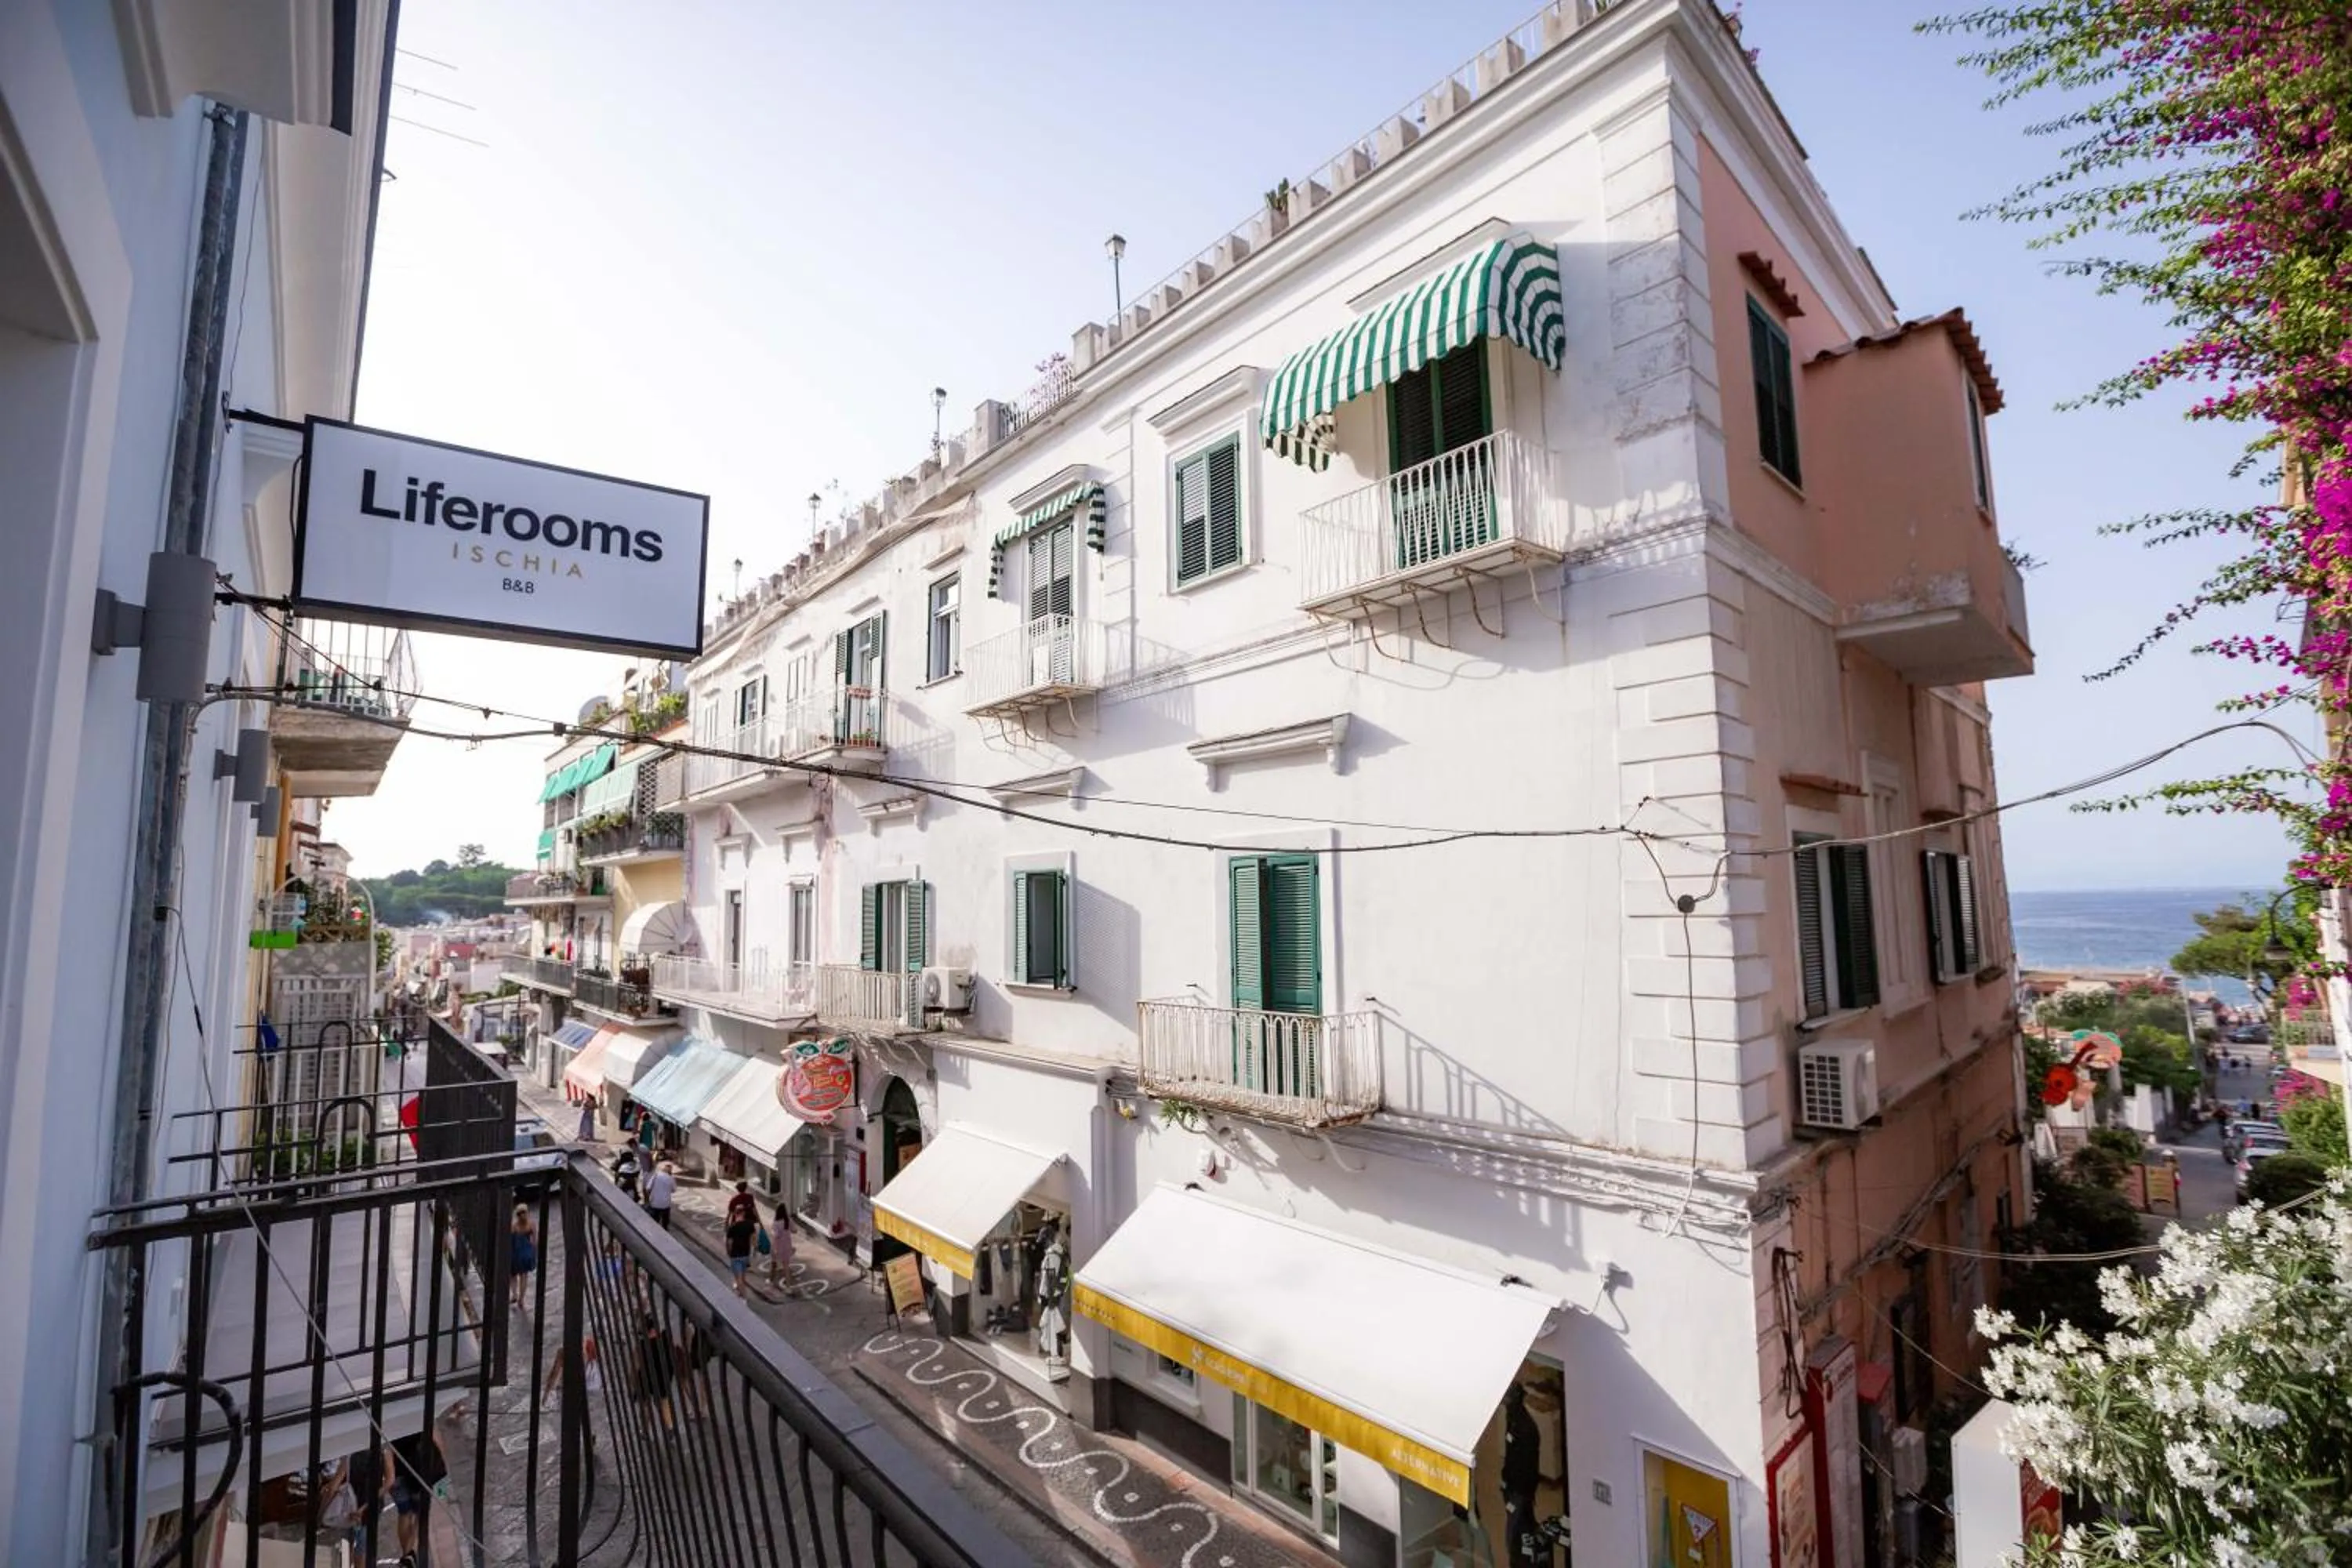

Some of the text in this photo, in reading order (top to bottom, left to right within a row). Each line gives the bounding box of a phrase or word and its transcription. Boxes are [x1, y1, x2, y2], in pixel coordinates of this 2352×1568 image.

[361, 469, 663, 562] Liferooms
[452, 542, 583, 578] ISCHIA
[503, 579, 535, 594] B&B
